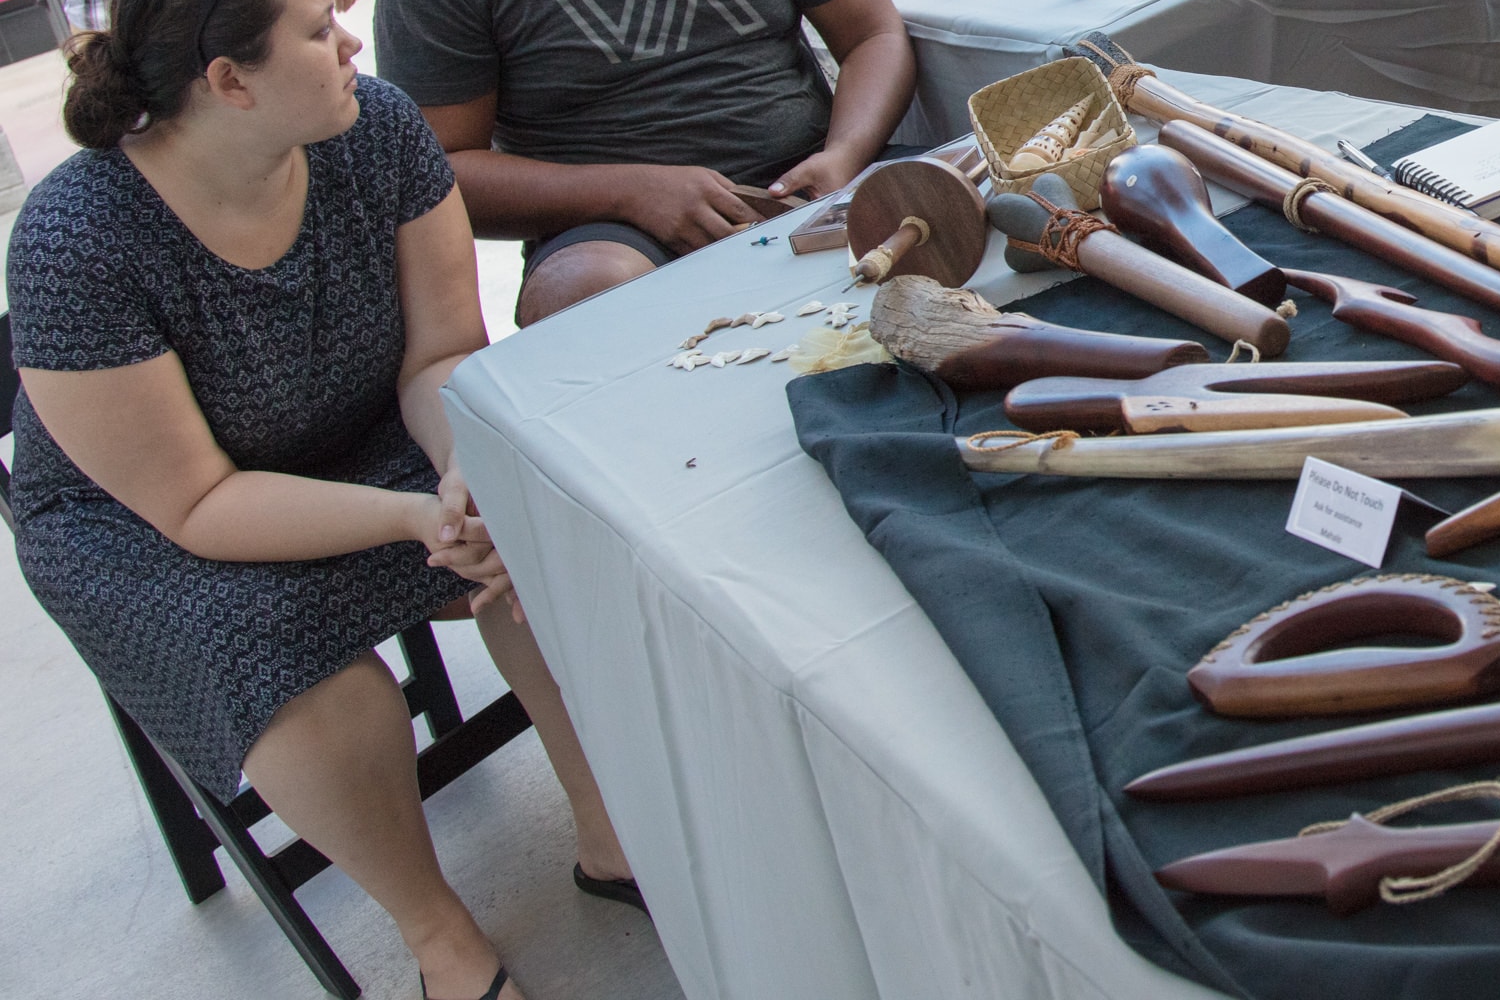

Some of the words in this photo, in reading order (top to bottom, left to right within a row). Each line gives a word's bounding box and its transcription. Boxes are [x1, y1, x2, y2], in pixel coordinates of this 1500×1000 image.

[1332, 480, 1344, 495] Do
[1344, 485, 1360, 502] Not
[1361, 491, 1385, 512] Touch
